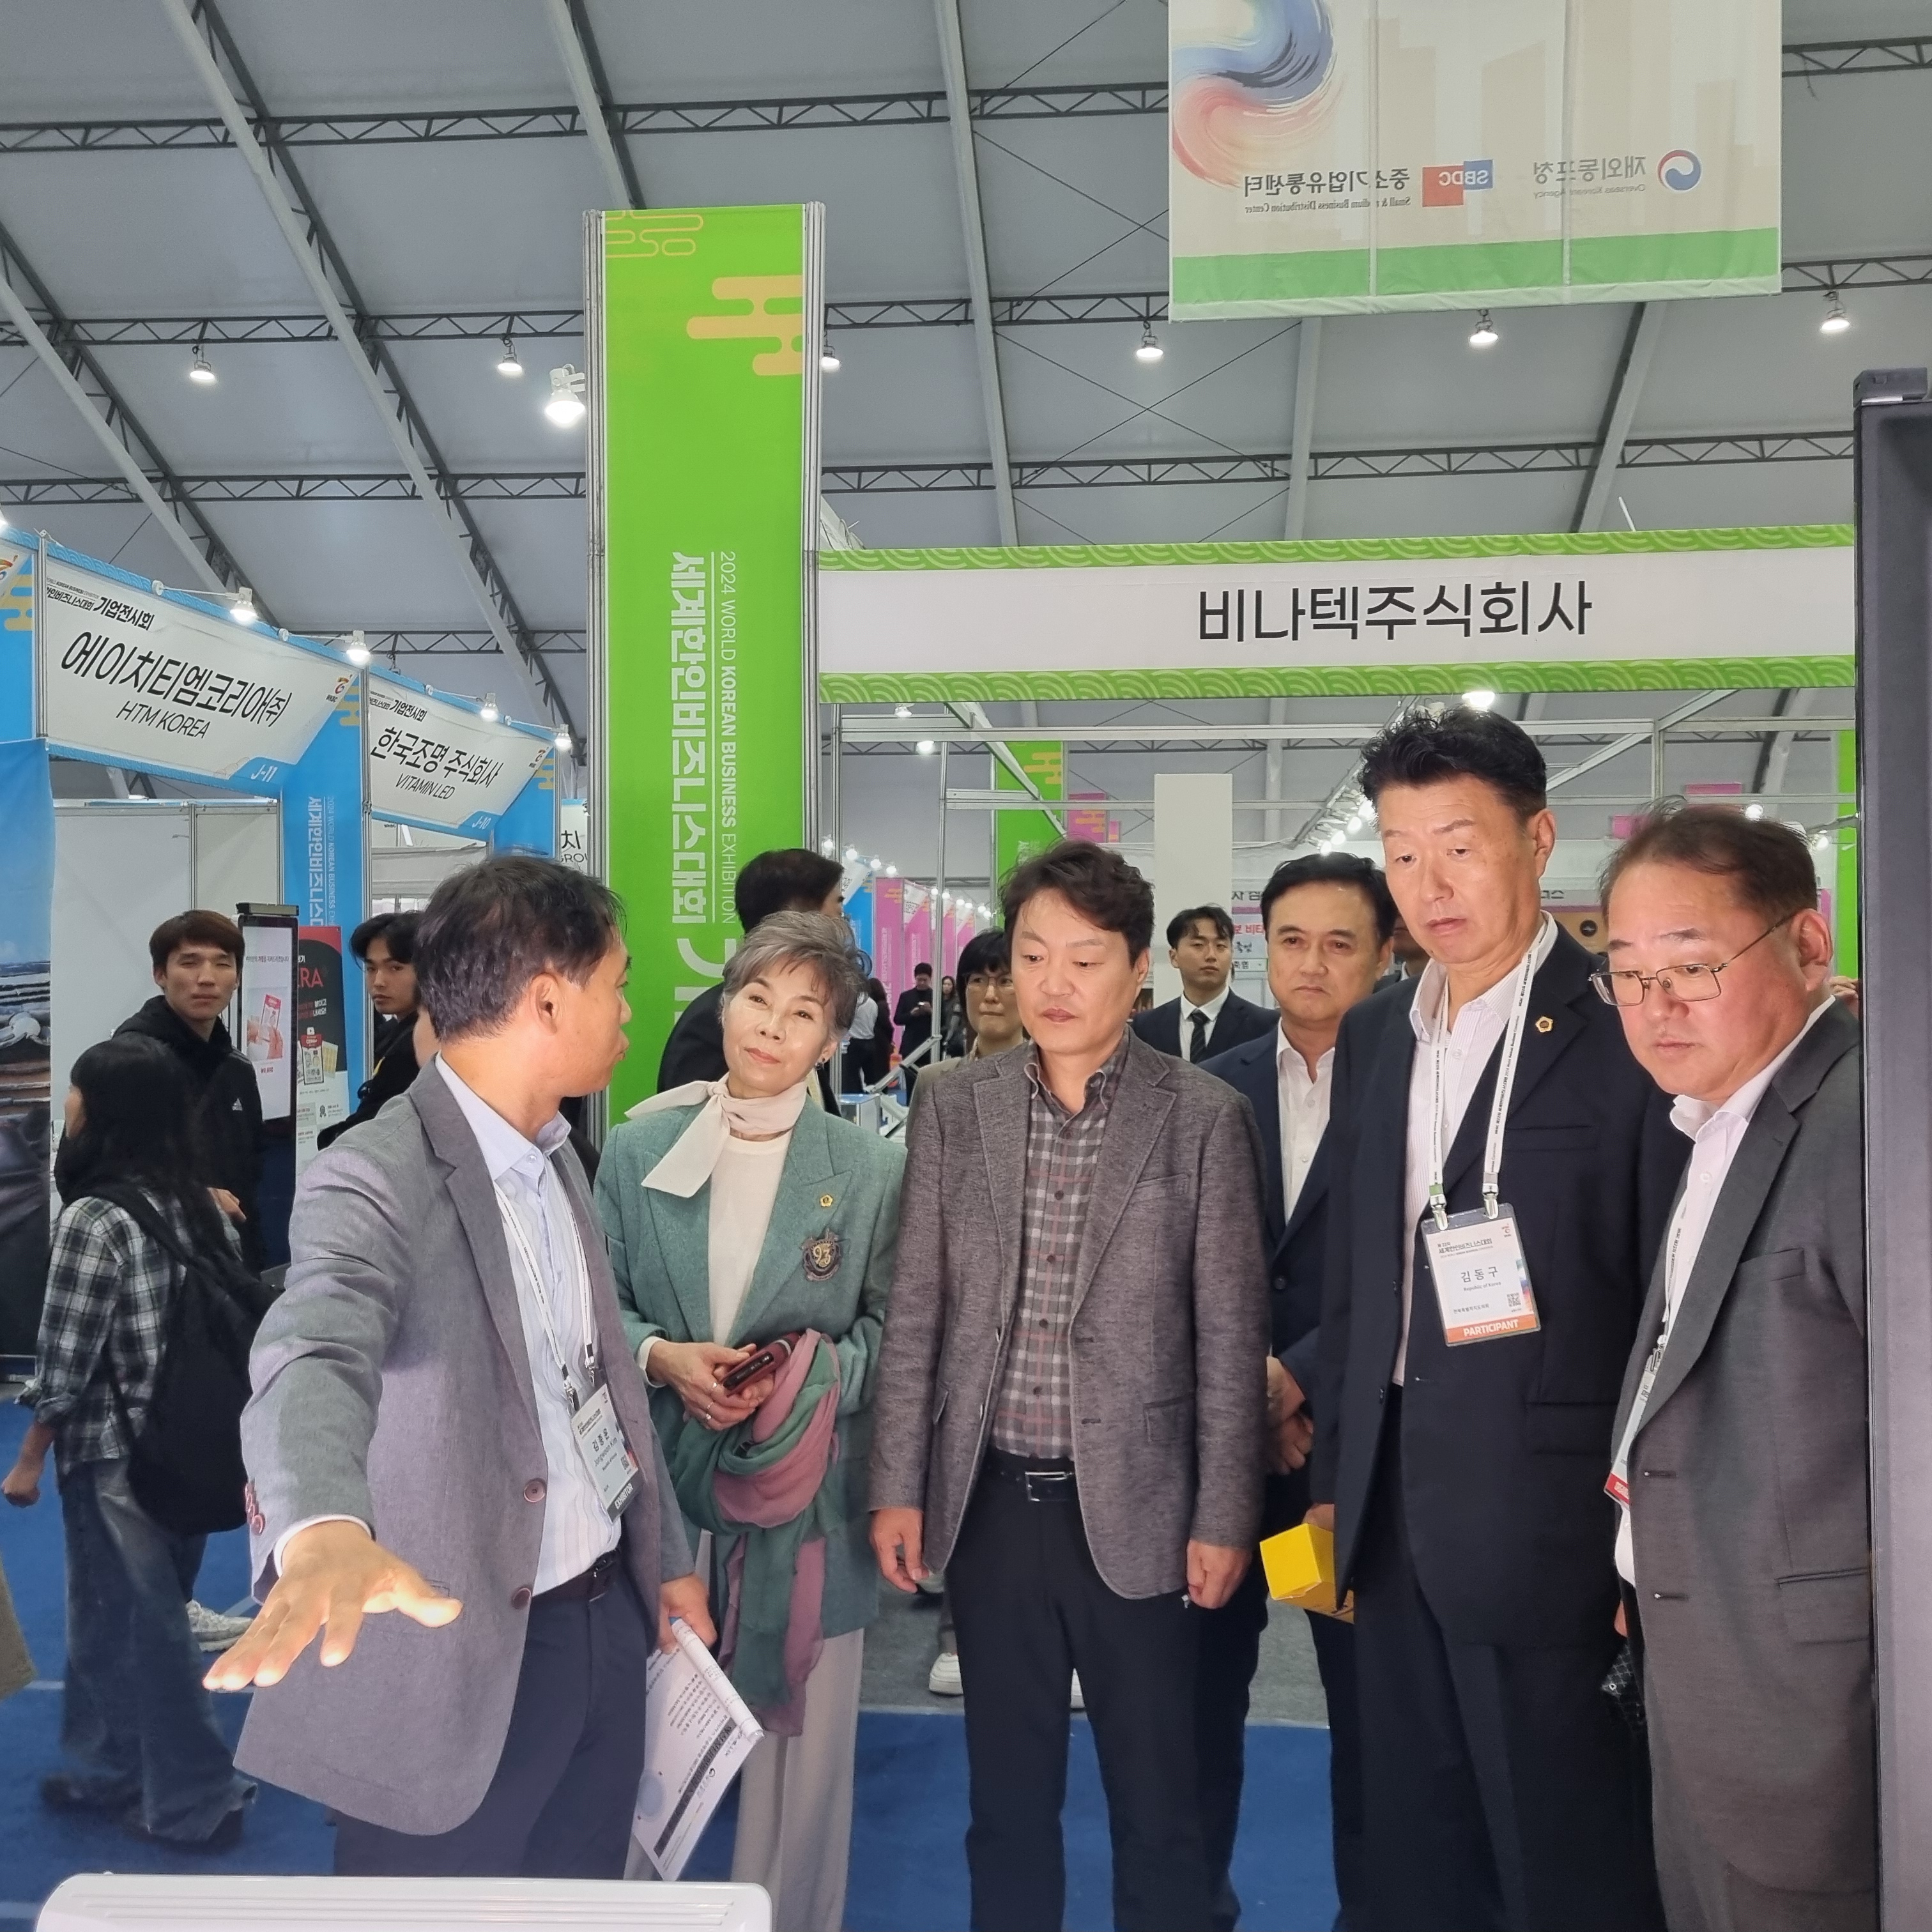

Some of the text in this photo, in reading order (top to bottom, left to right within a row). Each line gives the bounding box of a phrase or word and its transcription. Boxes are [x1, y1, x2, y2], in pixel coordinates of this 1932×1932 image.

[93, 596, 155, 631] 기업전시회
[1199, 580, 1593, 642] 비나텍주식회사
[61, 631, 293, 728] 에이치티엠코리아(주)
[116, 700, 211, 739] HTM KOREA
[389, 699, 428, 723] 기업전시회
[671, 551, 707, 924] 세계한인비즈니스대회
[720, 551, 737, 924] 2024 WORLD KOREAN BUSINESS EXHIBITION
[250, 764, 278, 783] J-11
[371, 726, 504, 788] 한국조명 주식회사
[434, 783, 456, 800] LED
[298, 967, 325, 988] RA
[1462, 1319, 1519, 1337] PARTICIPANT
